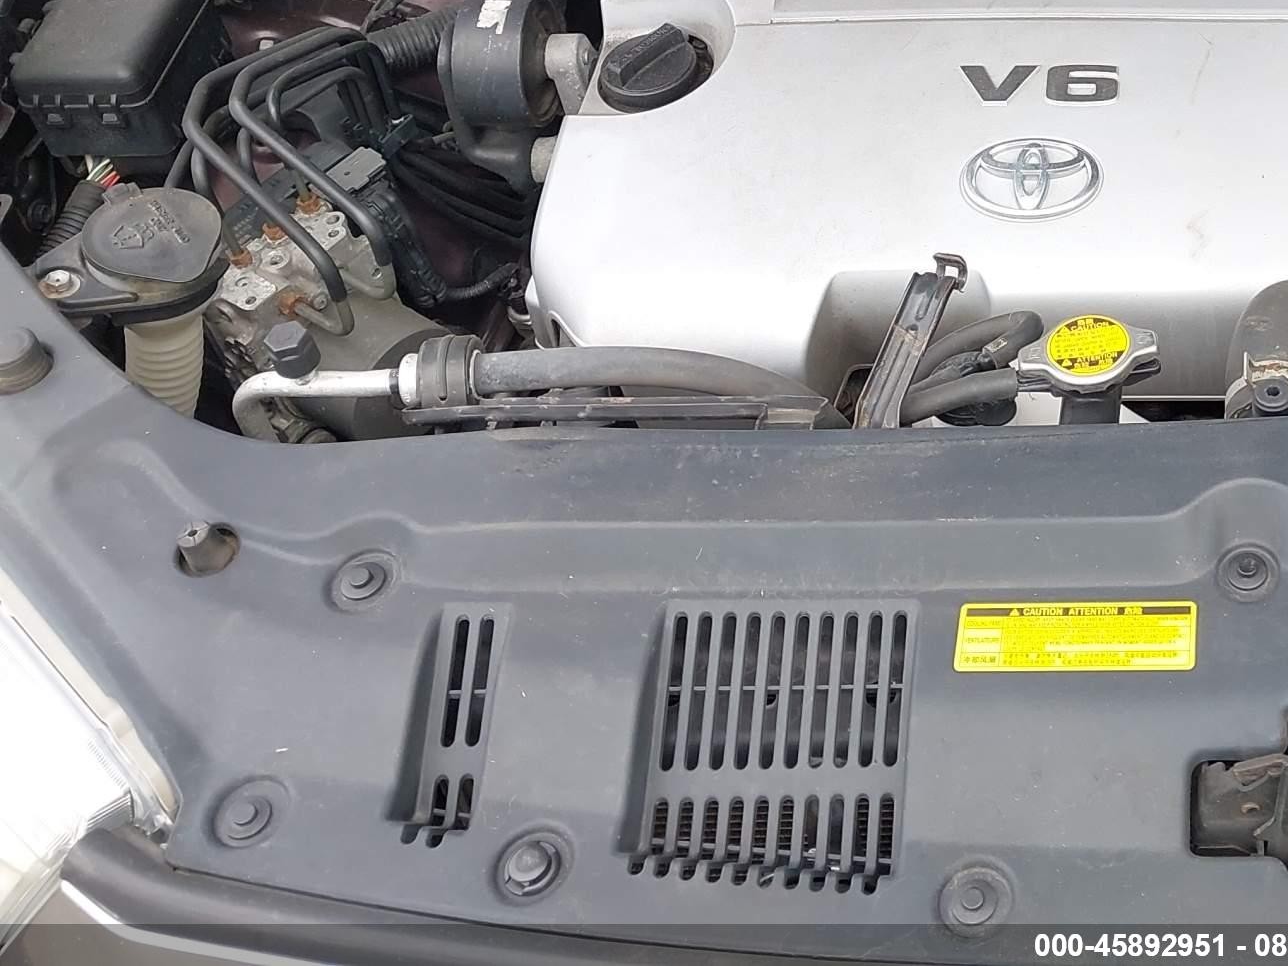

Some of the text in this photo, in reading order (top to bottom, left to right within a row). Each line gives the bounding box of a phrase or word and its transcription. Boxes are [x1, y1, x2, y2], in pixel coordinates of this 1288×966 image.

[959, 64, 1120, 106] V6
[1023, 607, 1063, 616] CAUTION
[1068, 607, 1118, 616] ATTENTION
